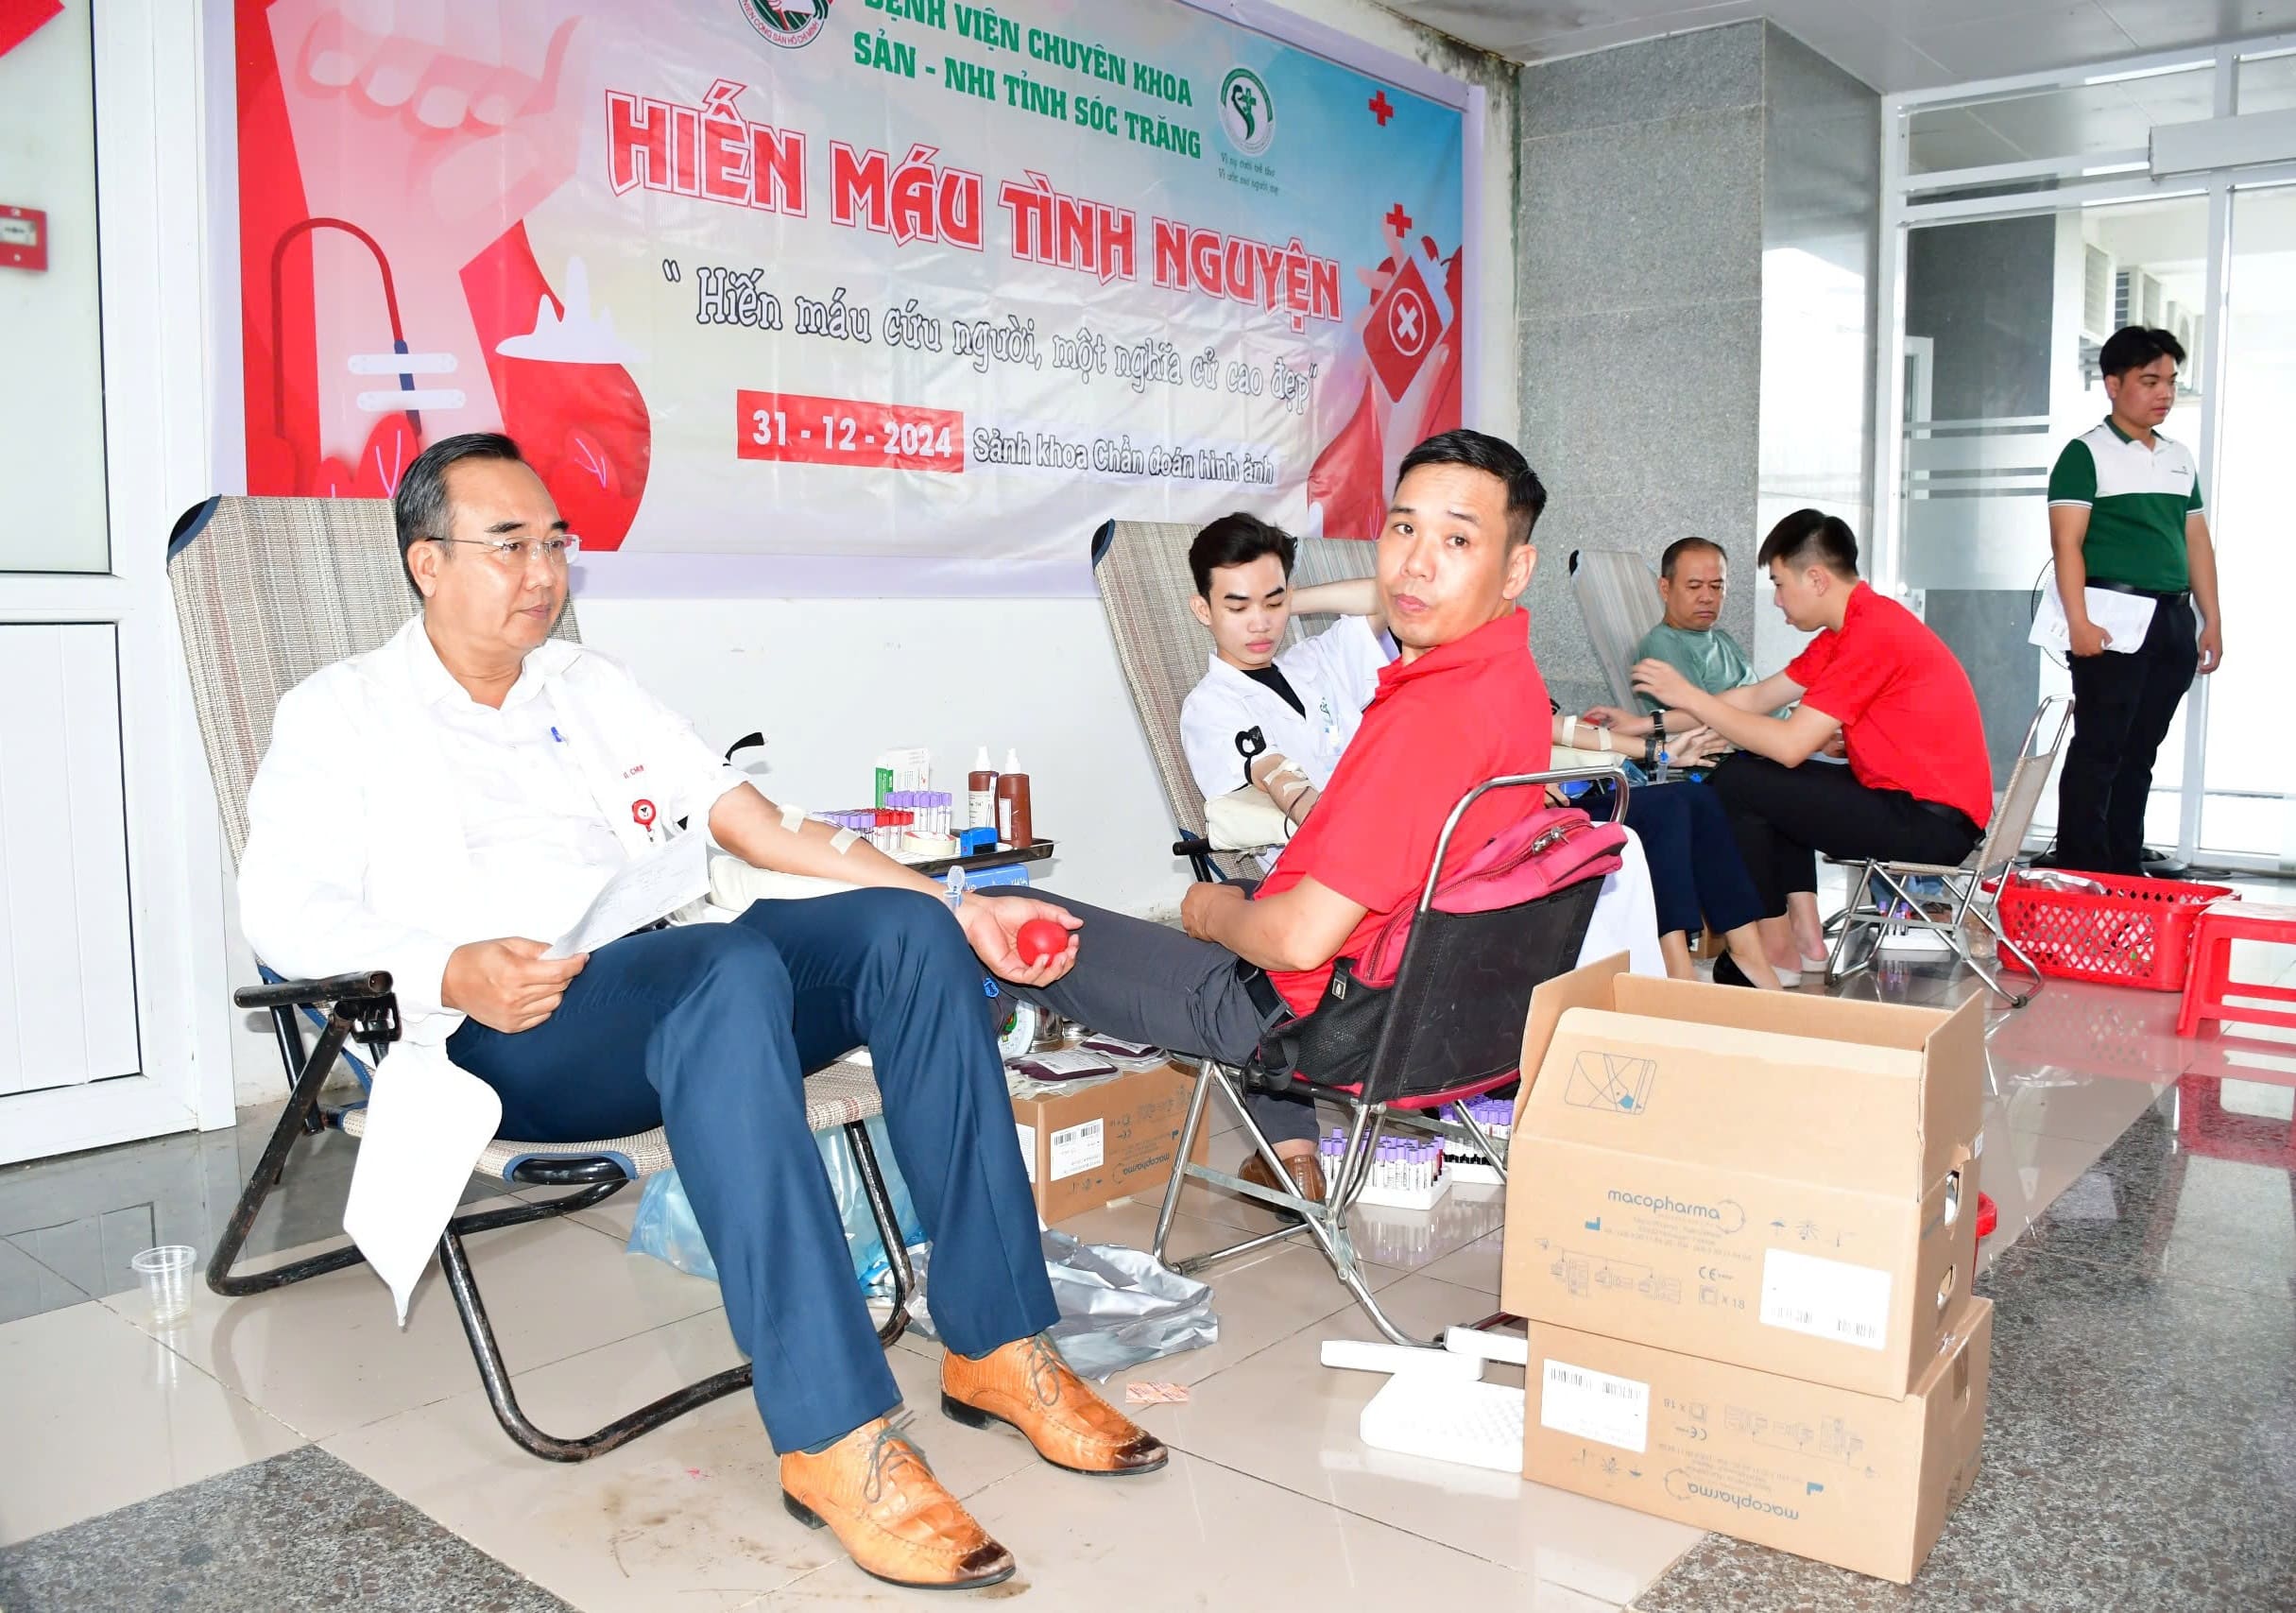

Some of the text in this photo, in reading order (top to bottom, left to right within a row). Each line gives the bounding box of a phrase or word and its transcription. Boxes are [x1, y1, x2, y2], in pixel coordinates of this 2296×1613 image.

[954, 3, 1019, 53] VIỆN
[1028, 27, 1126, 86] CHUYÊN
[1134, 61, 1192, 107] KHOA
[854, 28, 916, 78] SẢN
[945, 57, 996, 101] NHI
[1003, 70, 1067, 121] TỈNH
[1074, 94, 1118, 136] SÓC
[1124, 113, 1201, 159] TRĂNG
[605, 77, 1343, 333] HIẾN MÁU TÌNH NGUYỆN
[696, 267, 782, 330] Hiến
[795, 287, 871, 343] máu
[882, 300, 943, 352] cứu
[952, 315, 1042, 373] người,
[1052, 327, 1106, 384] một
[1115, 337, 1183, 393] nghĩa
[1191, 347, 1219, 389] cử
[1227, 361, 1263, 396] cao
[753, 410, 786, 446] 31
[822, 416, 856, 451] 12
[883, 420, 952, 458] 2024
[972, 427, 1274, 485] Sảnh khoa Chẩn đoán hình ảnh
[1122, 1153, 1171, 1175] macopharma
[1607, 1189, 1721, 1221] macopharma
[1687, 1482, 1800, 1520] macopharma
